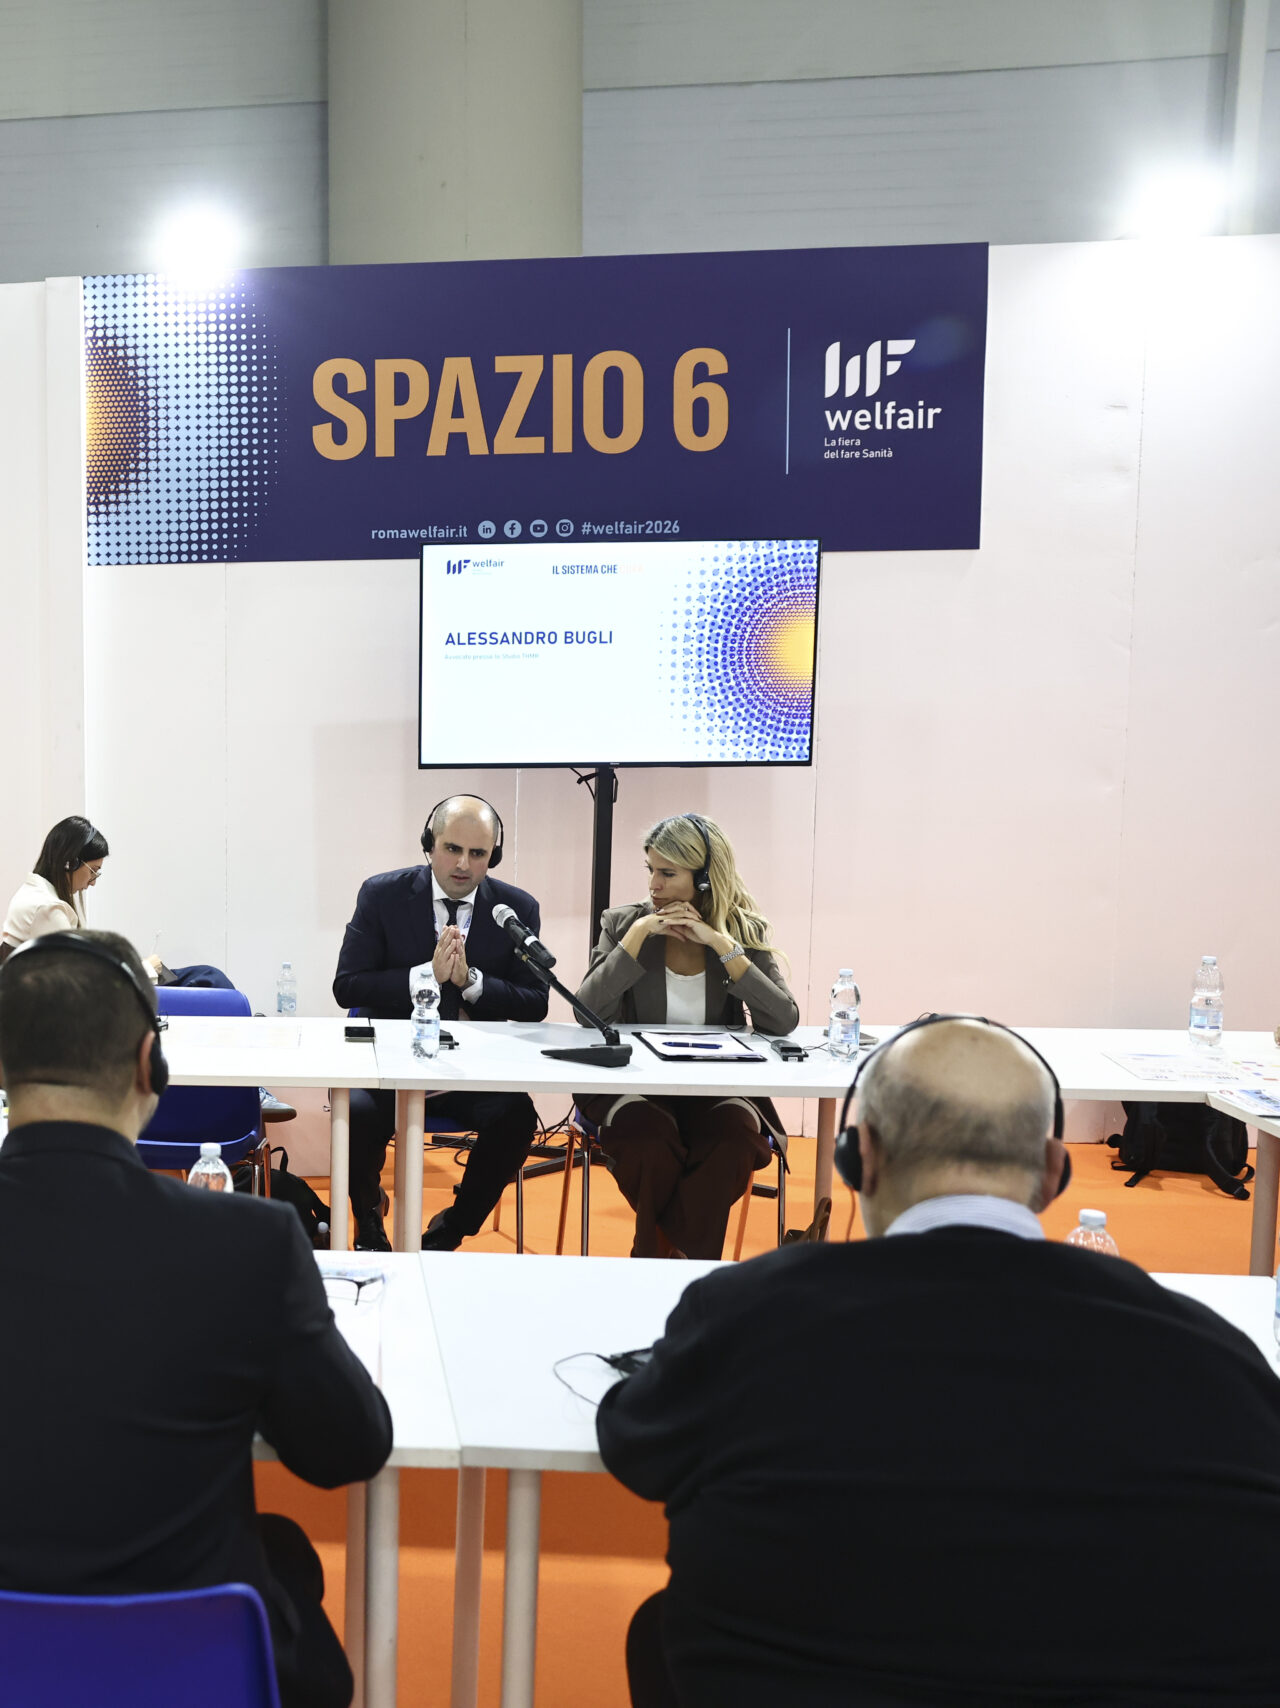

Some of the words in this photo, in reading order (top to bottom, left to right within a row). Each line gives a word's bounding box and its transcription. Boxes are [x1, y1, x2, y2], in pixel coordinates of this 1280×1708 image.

[312, 350, 644, 461] SPAZIO
[673, 347, 729, 452] 6
[824, 400, 942, 431] welfair
[824, 437, 837, 447] La
[838, 437, 861, 446] fiera
[824, 449, 839, 459] del
[840, 449, 861, 458] fare
[862, 447, 893, 458] Sanità
[371, 525, 468, 539] romawelfair.it
[581, 520, 680, 535] #welfair2026
[472, 559, 505, 568] welfair
[552, 565, 560, 575] IL
[561, 564, 599, 575] SISTEMA
[600, 564, 618, 574] CHE
[445, 631, 558, 646] ALESSANDRO
[564, 630, 613, 645] BUGLI
